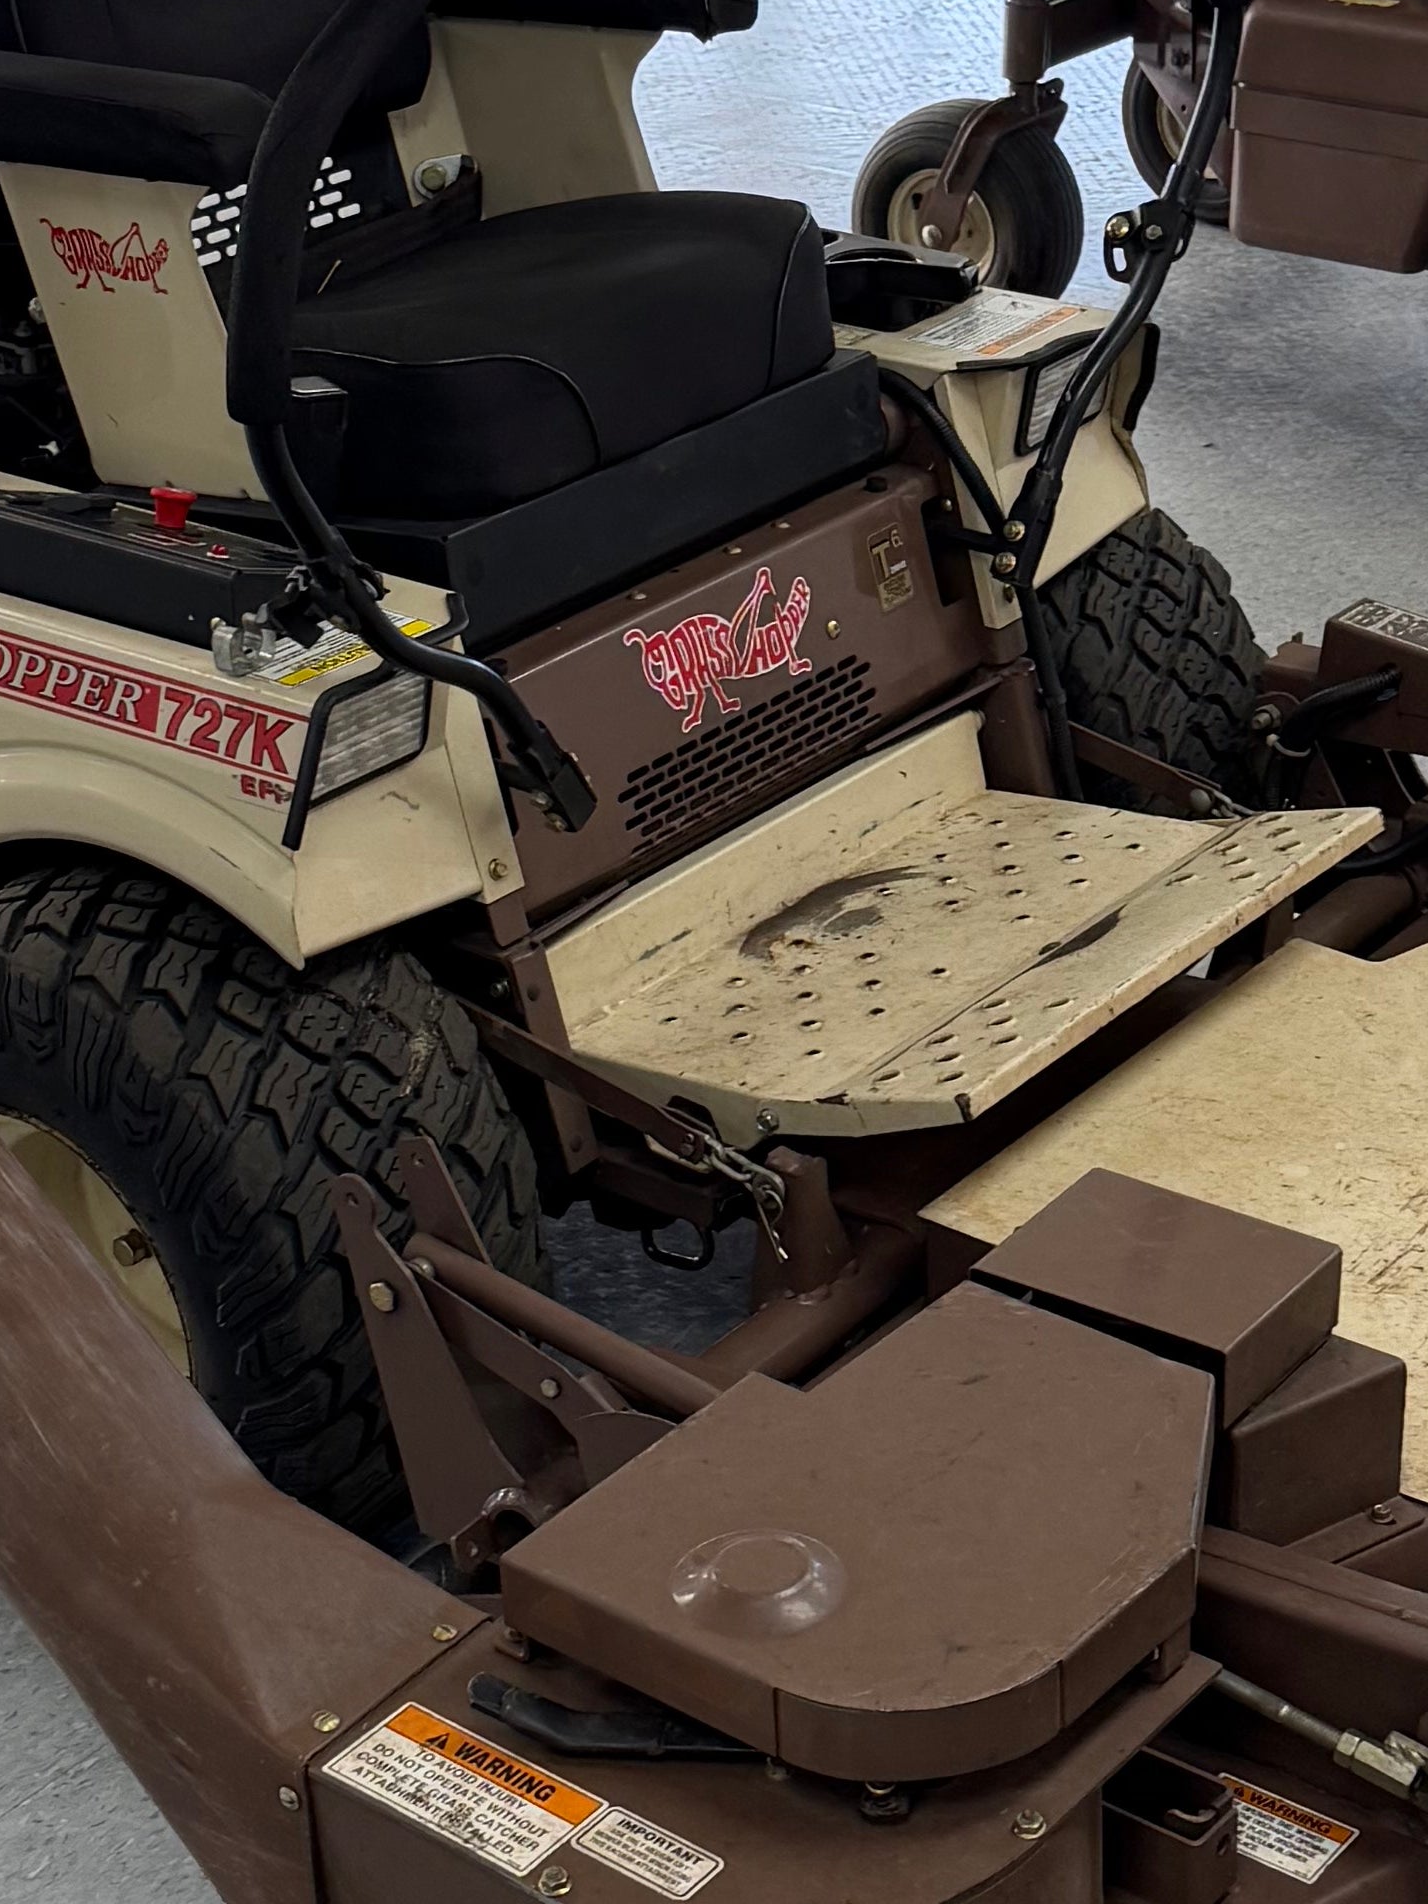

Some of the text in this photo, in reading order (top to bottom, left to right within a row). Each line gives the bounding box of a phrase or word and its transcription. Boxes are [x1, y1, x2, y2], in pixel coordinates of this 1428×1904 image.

[163, 686, 294, 775] 727K
[371, 1743, 550, 1839] DO NOT OPERATE WITHOUT
[415, 1747, 435, 1765] TO
[436, 1760, 480, 1784] AVOID
[455, 1741, 557, 1804] WARNING
[357, 1751, 429, 1793] COMPLETE
[474, 1812, 541, 1853] CATCHER
[1249, 1791, 1333, 1835] WARNING
[617, 1818, 705, 1866] IMPORTANT
